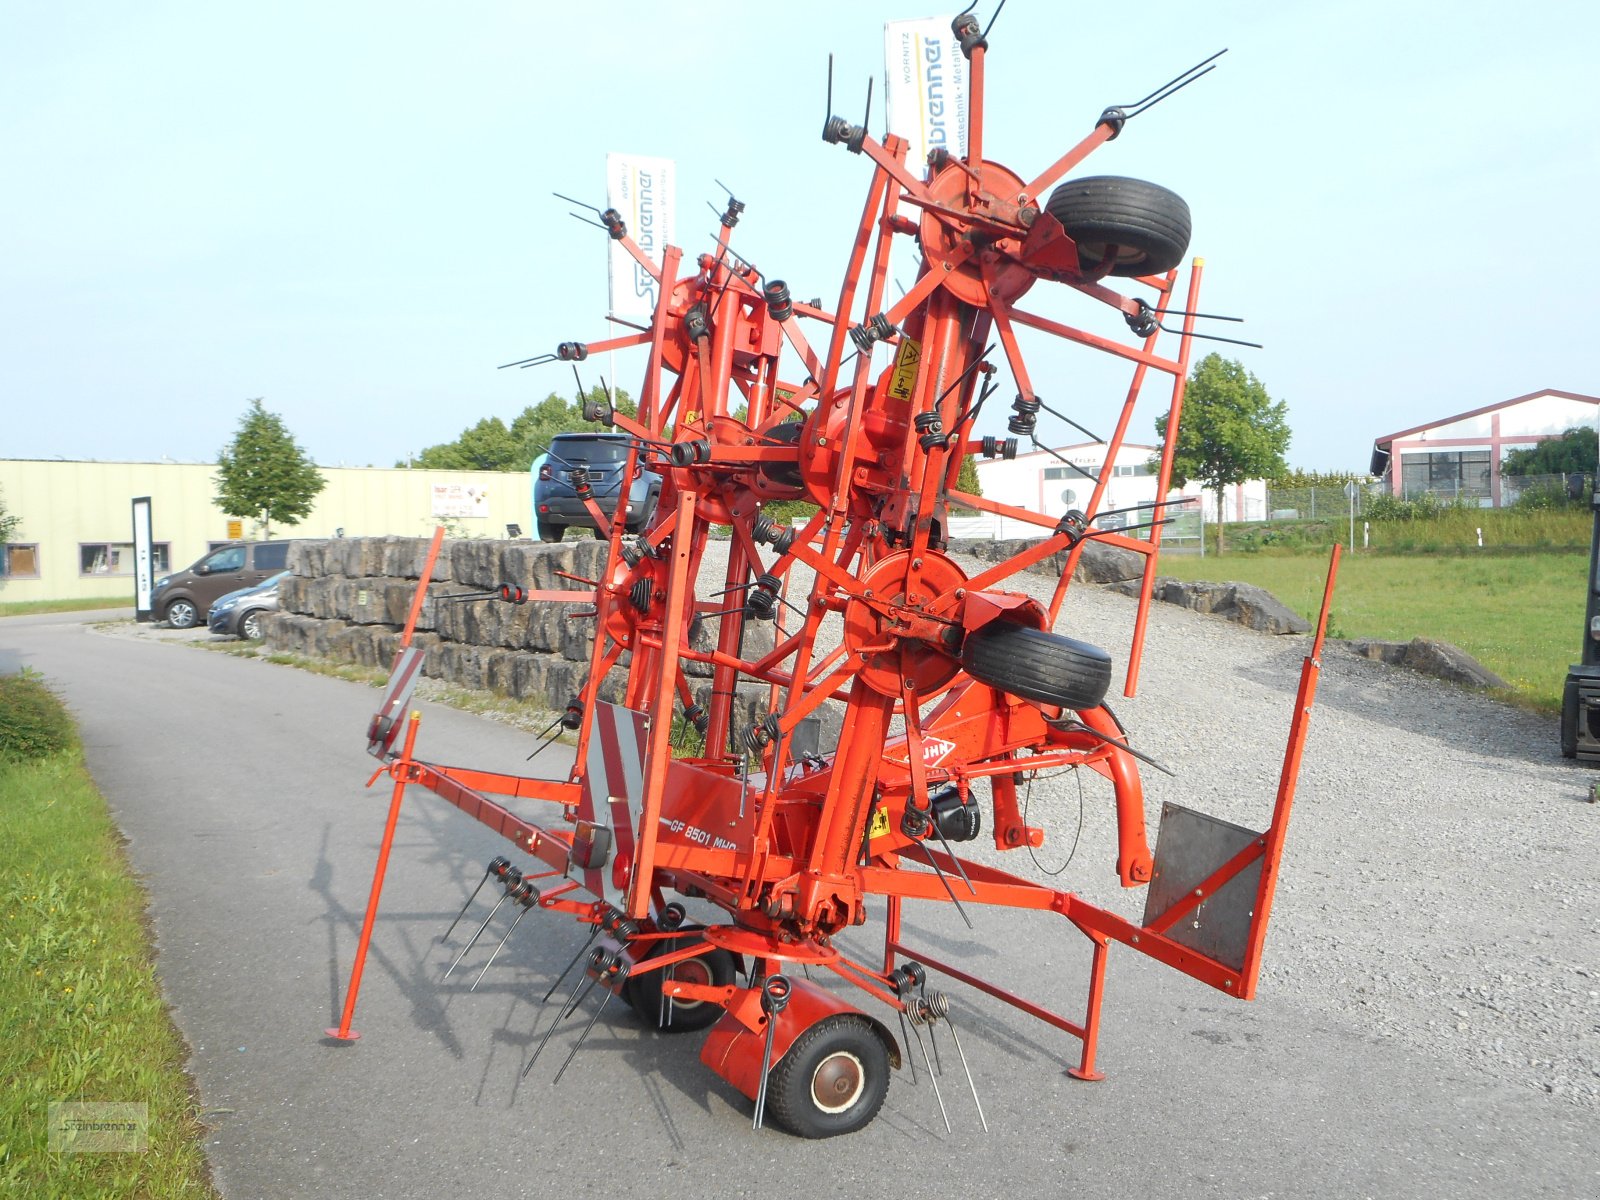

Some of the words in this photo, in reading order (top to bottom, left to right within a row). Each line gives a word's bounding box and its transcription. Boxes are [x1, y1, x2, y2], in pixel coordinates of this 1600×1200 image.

[951, 36, 962, 85] Metallb
[954, 92, 966, 155] andtechnik
[634, 170, 655, 310] Stnbrenner
[670, 819, 686, 833] GF
[684, 826, 711, 846] 8501
